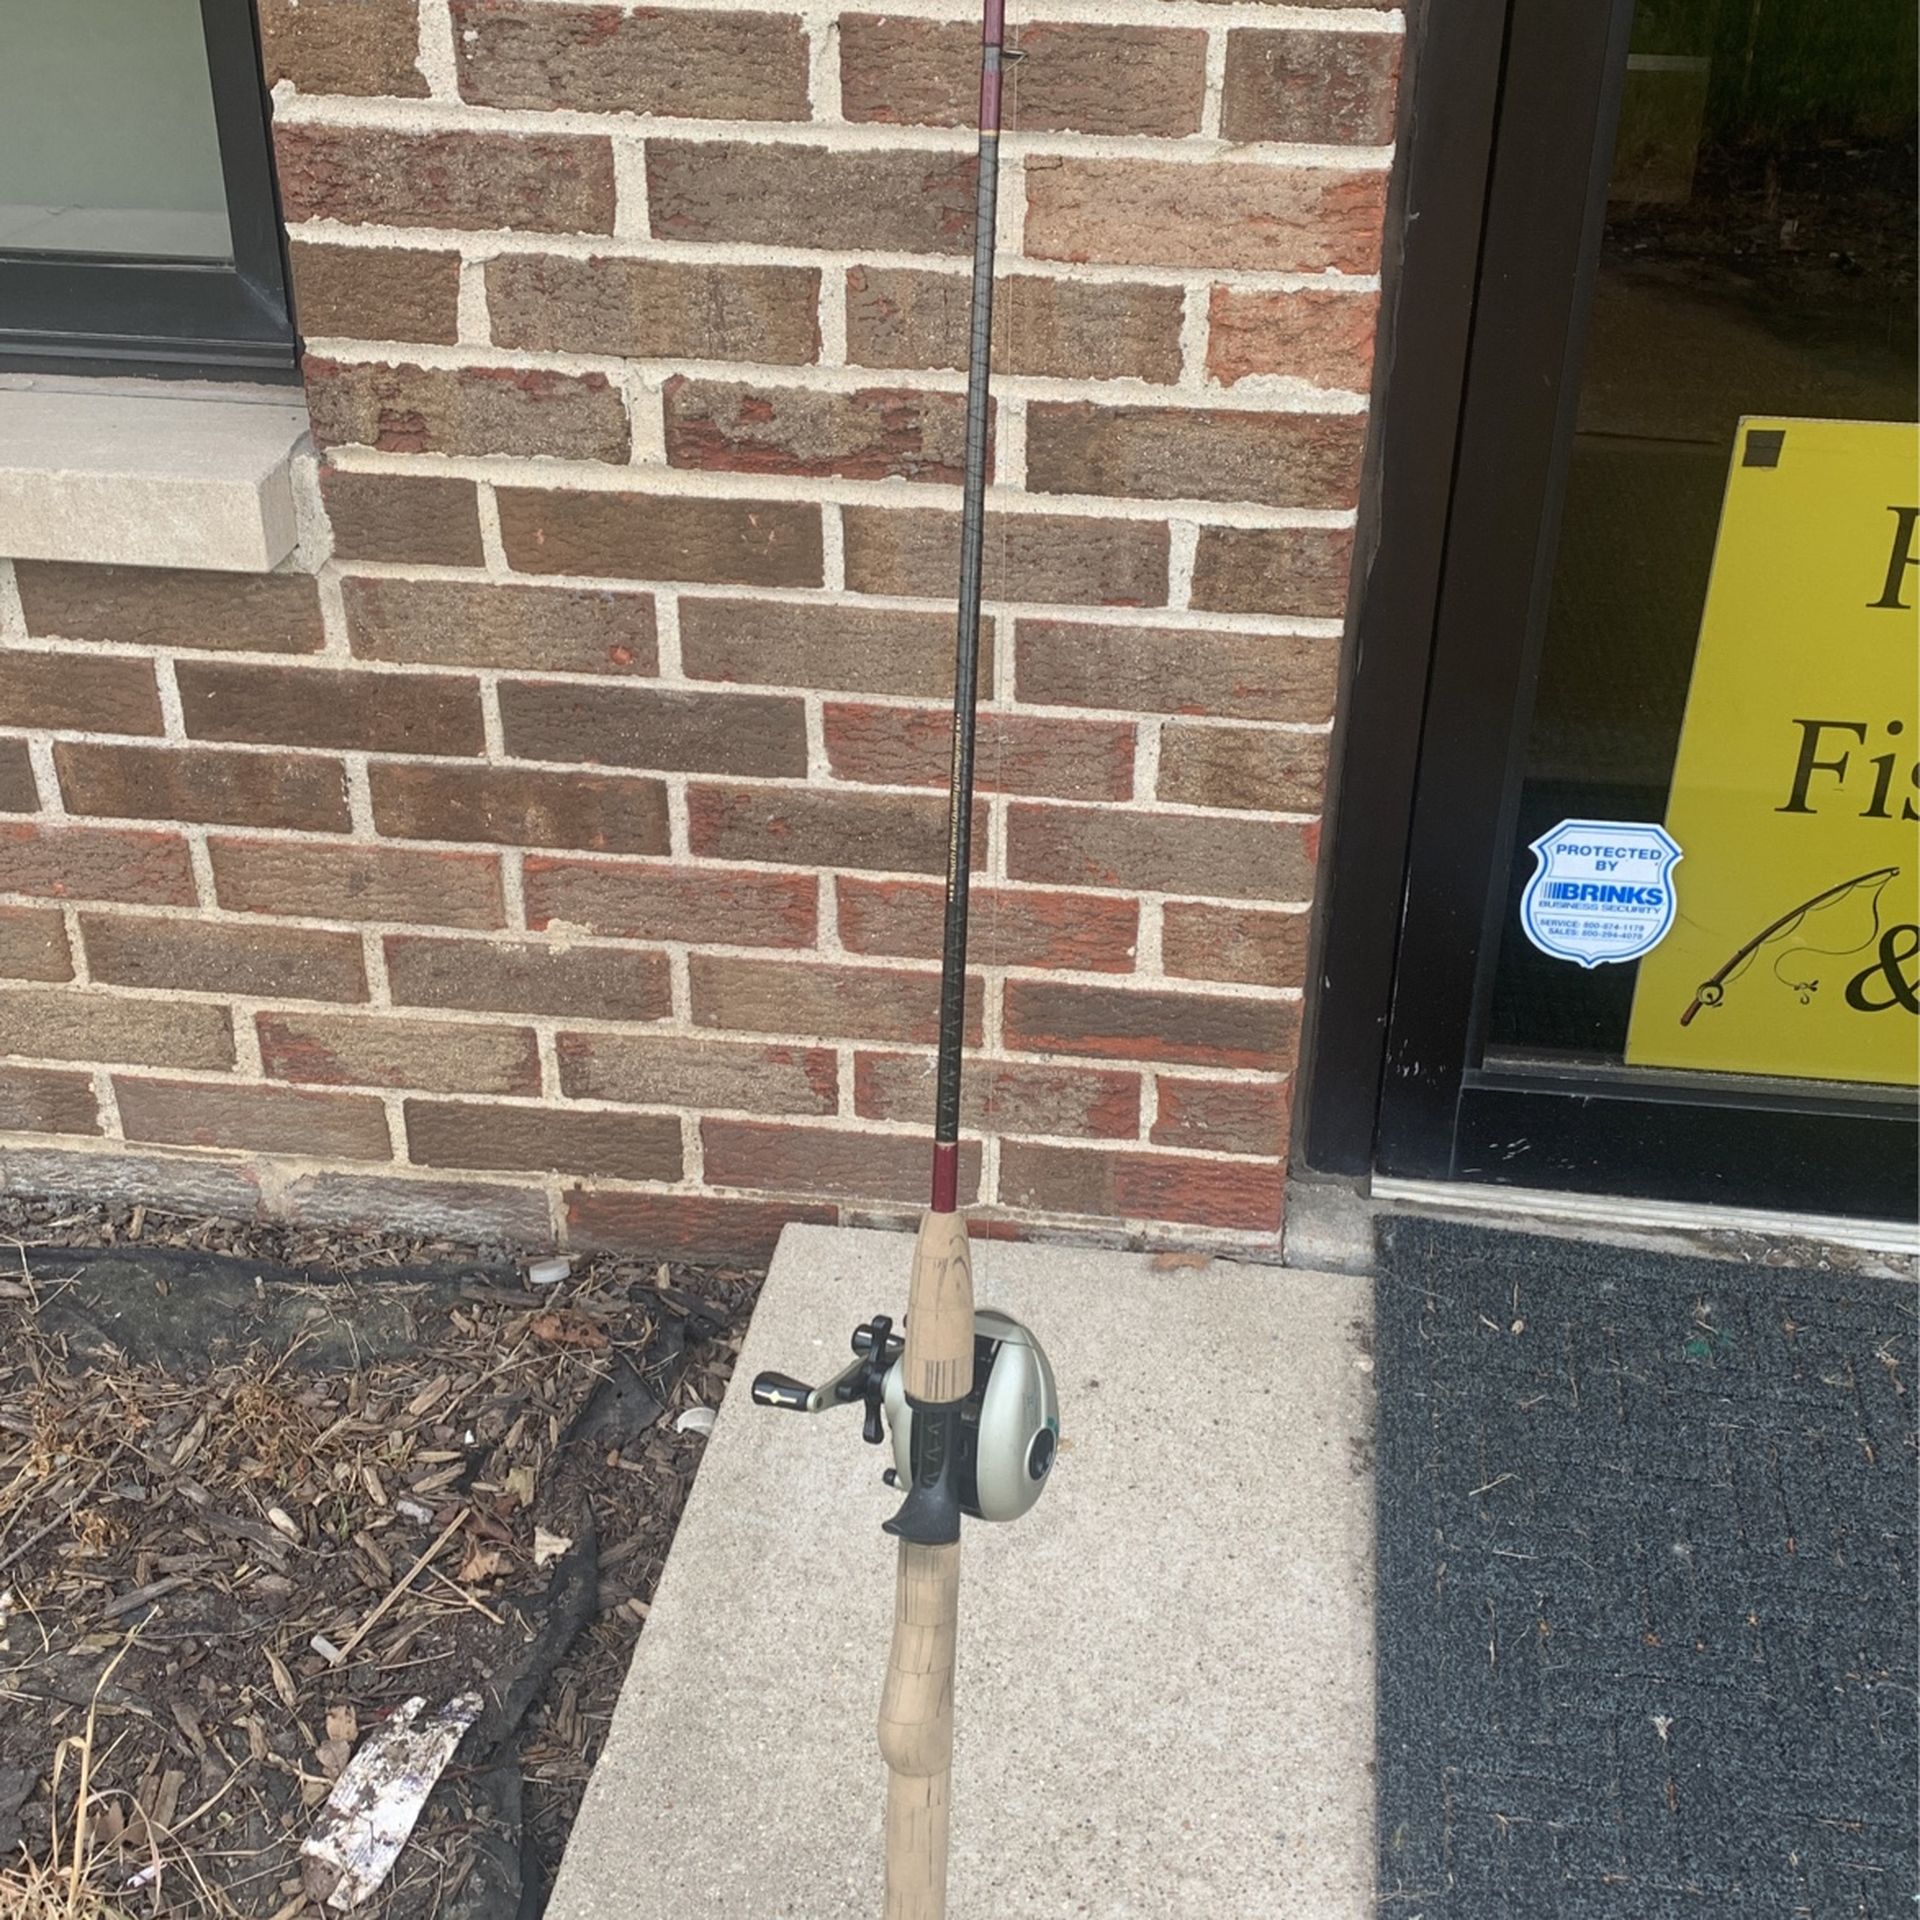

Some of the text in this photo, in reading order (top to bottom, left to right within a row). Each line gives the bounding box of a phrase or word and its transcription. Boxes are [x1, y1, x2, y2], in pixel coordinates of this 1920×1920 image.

[1556, 844, 1662, 860] PROTECTED
[1595, 860, 1618, 871] BY
[1560, 882, 1664, 906] BRINKS
[1538, 900, 1661, 914] BUSINESS SECURITY
